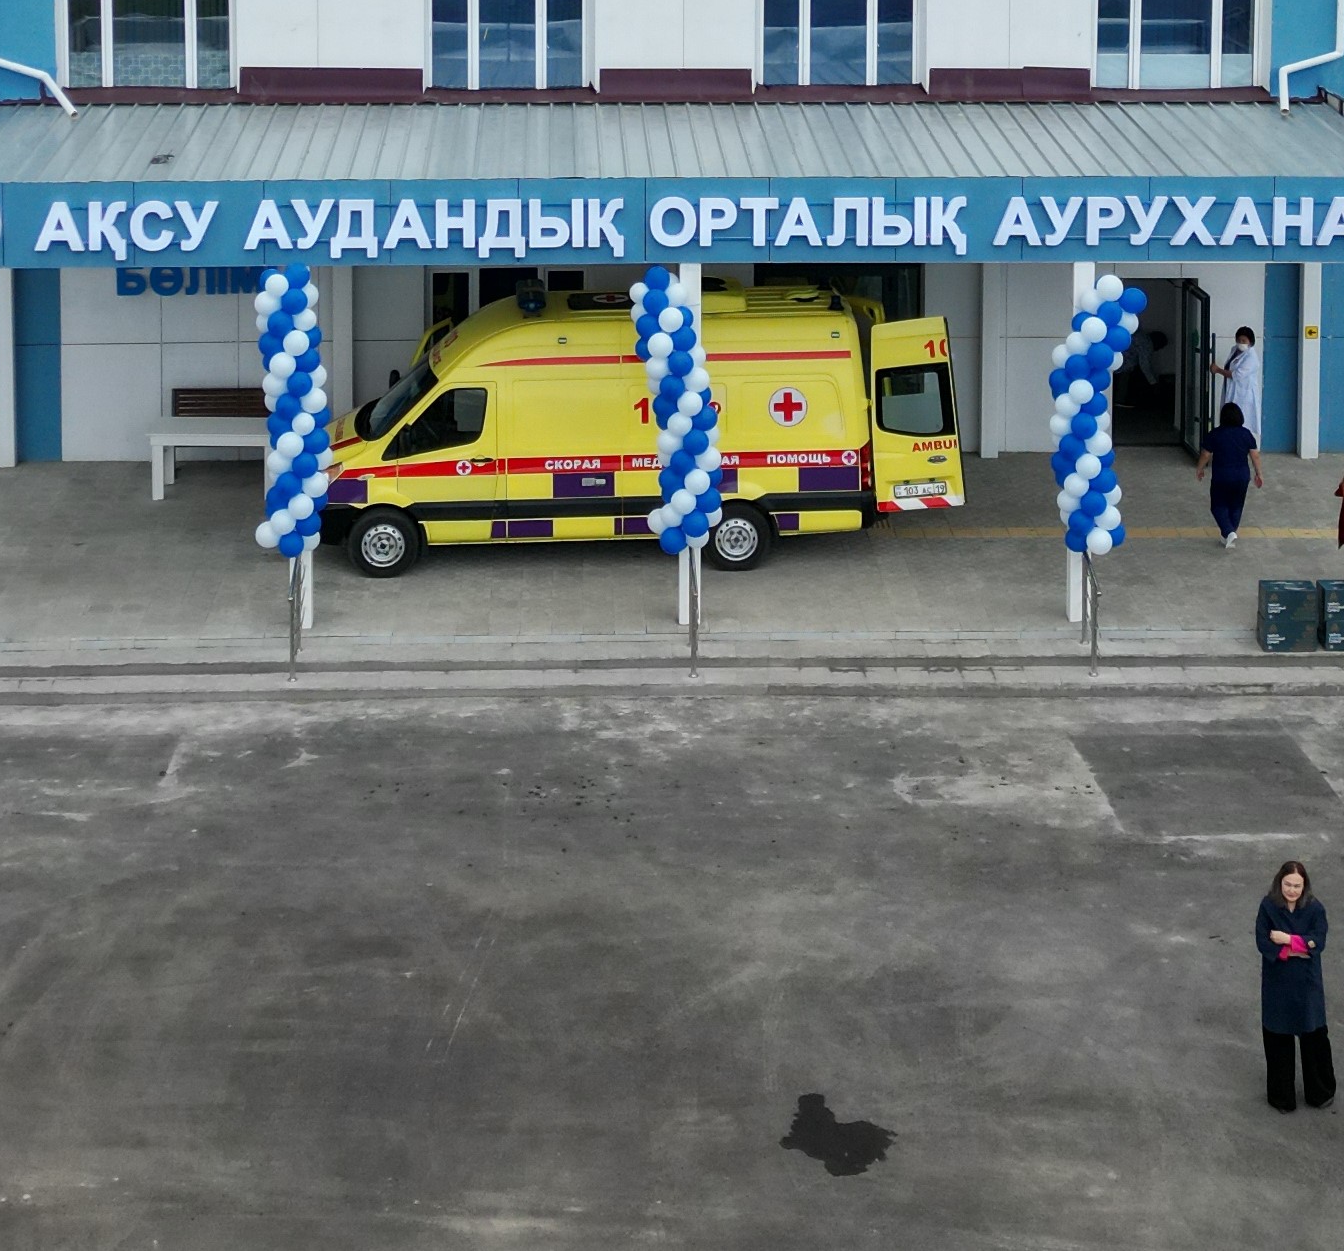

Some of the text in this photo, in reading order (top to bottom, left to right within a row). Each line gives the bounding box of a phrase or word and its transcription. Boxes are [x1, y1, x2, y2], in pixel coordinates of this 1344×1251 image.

[35, 200, 219, 261] АҚСУ
[244, 198, 624, 259] АУДАНДЫҚ
[650, 196, 967, 255] ОРТАЛЫҚ
[116, 266, 280, 296] БӨЛІМ
[544, 452, 831, 470] СКОРАЯ ПОМОЩЬ
[904, 485, 919, 495] 103
[935, 484, 945, 494] 19
